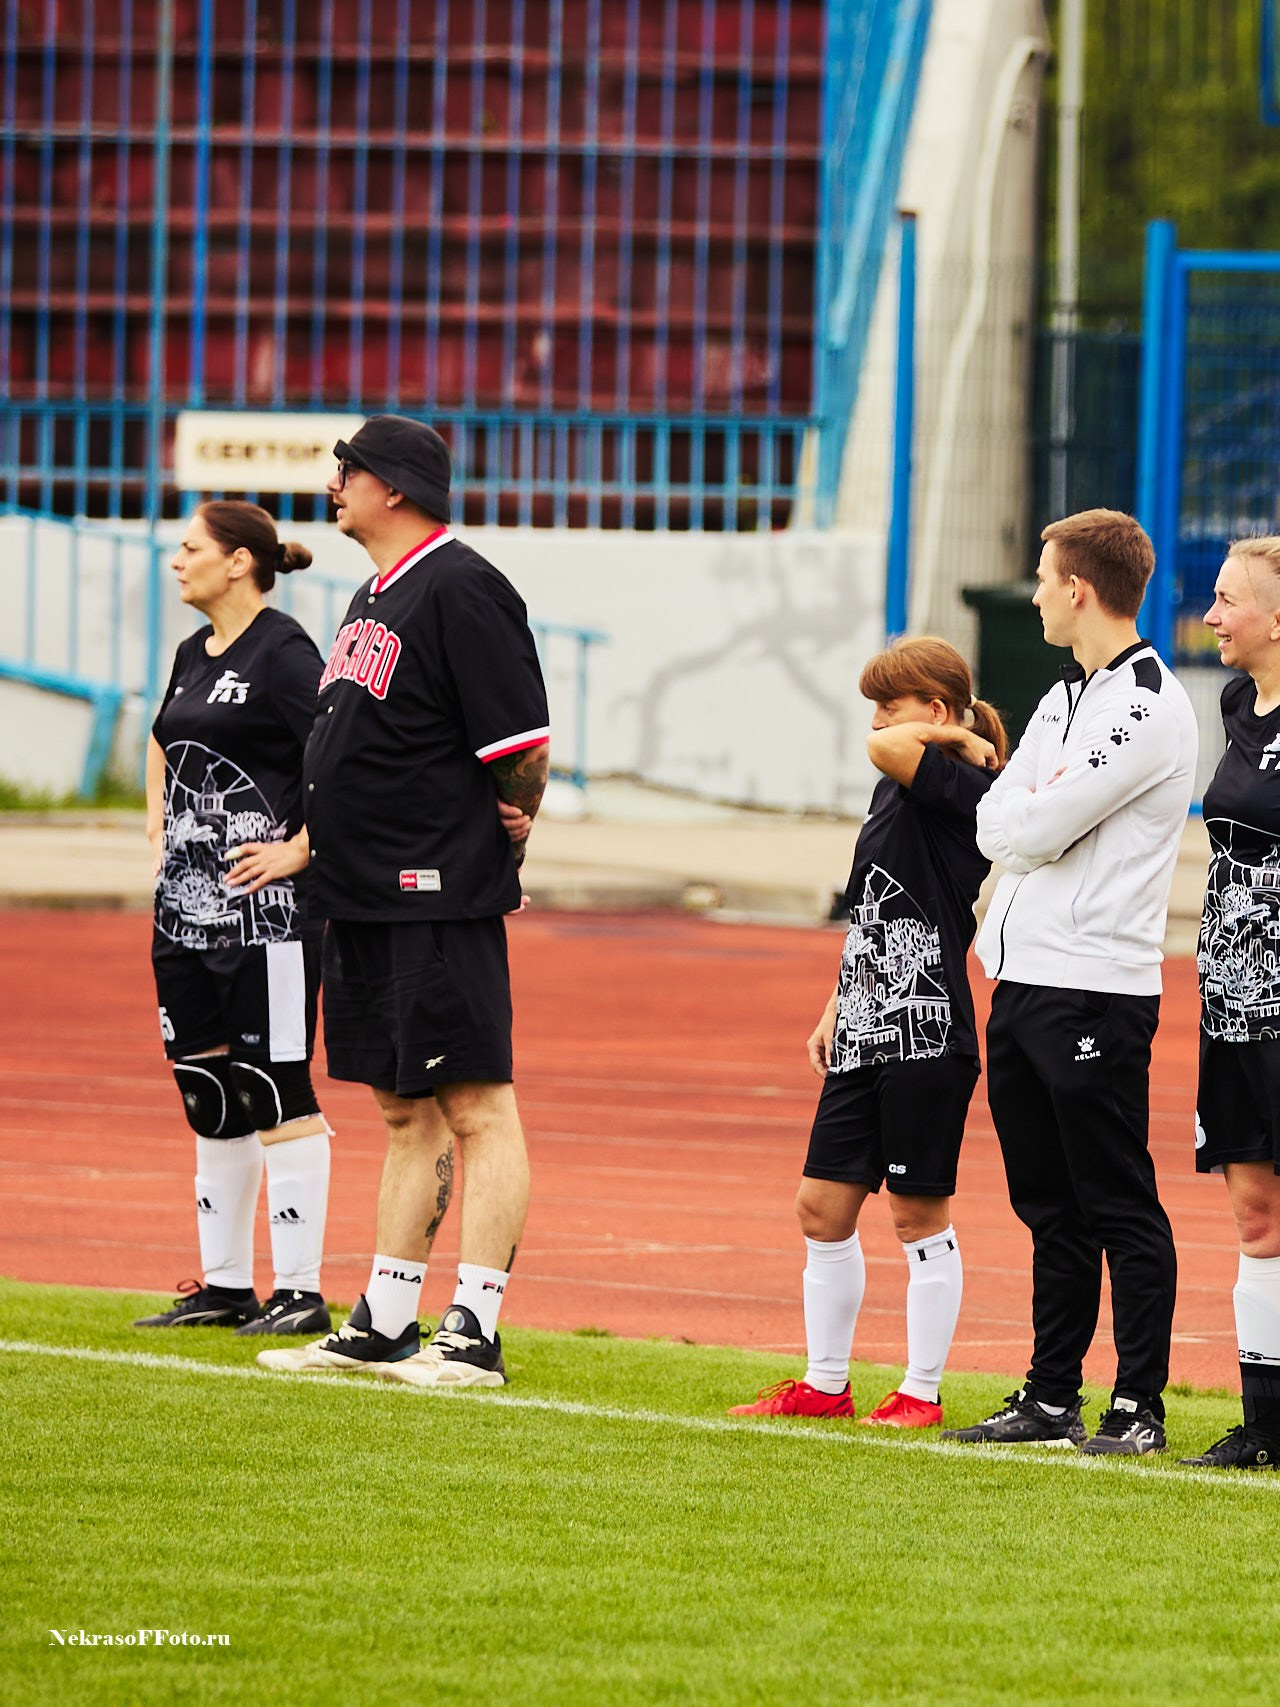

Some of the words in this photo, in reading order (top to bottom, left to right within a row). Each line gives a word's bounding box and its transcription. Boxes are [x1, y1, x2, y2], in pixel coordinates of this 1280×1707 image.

[197, 439, 326, 462] СЕКТОР
[1074, 1050, 1101, 1062] KELME
[378, 1268, 422, 1284] FILA
